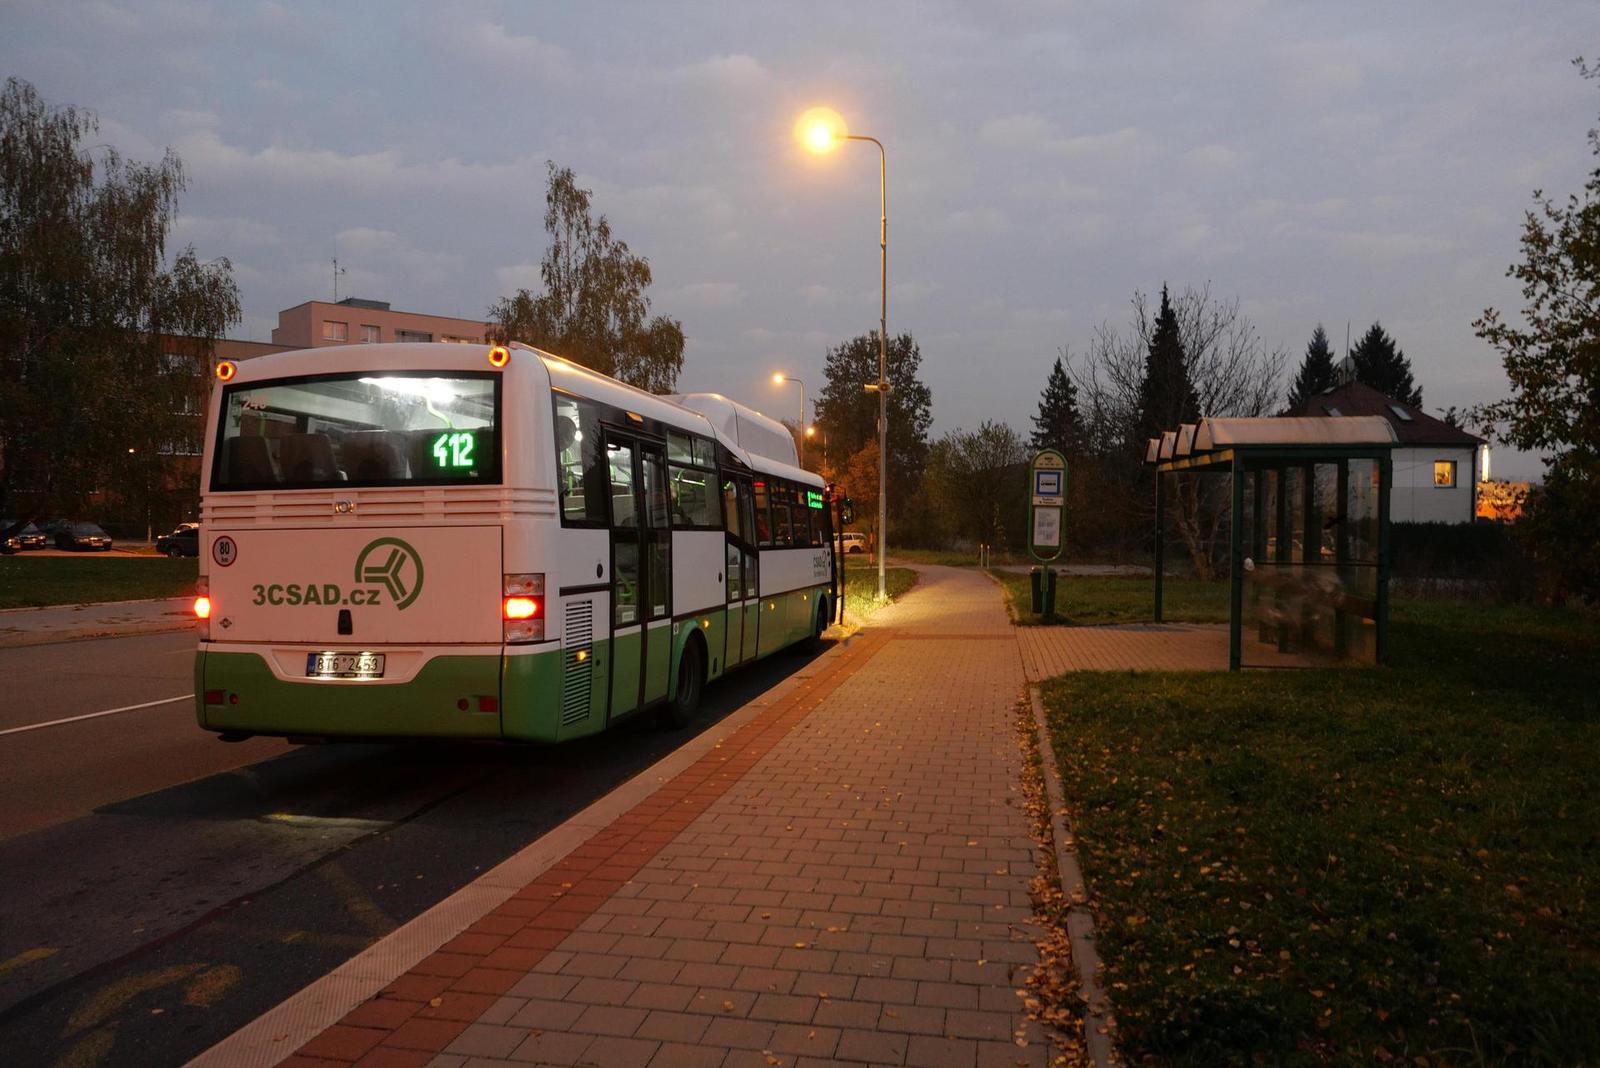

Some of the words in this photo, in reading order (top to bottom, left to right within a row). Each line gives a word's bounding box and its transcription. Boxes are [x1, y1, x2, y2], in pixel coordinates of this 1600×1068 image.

[433, 433, 473, 467] 412
[219, 541, 230, 555] 80
[252, 584, 381, 605] 3CSAD.cz
